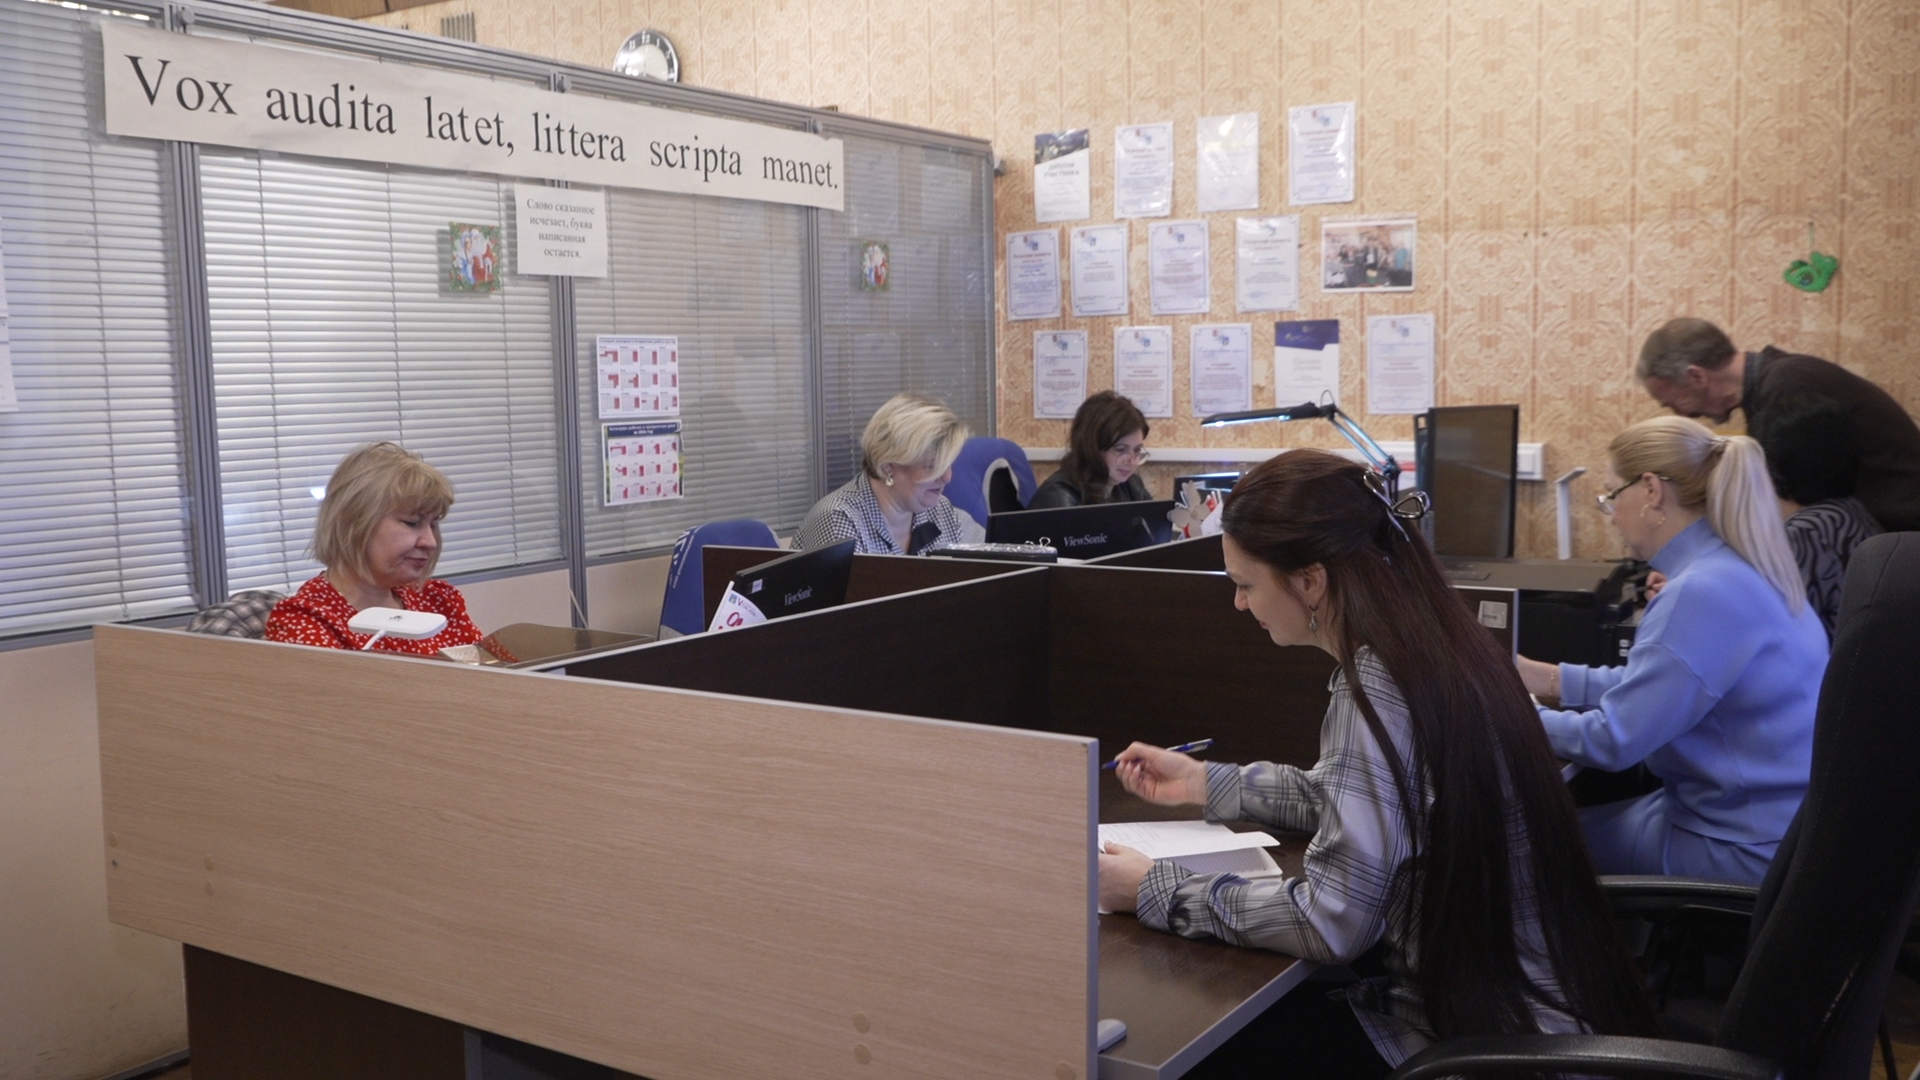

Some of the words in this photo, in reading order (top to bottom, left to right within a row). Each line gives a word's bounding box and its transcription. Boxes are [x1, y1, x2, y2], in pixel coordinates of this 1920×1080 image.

[124, 54, 238, 115] Vox
[265, 83, 397, 134] audita
[424, 96, 515, 156] latet,
[532, 111, 627, 163] littera
[649, 135, 743, 182] scripta
[762, 155, 839, 190] manet.
[526, 198, 553, 211] Слово
[554, 203, 595, 215] сказанное
[529, 216, 569, 229] исчезает,
[570, 217, 593, 231] буква
[538, 232, 586, 244] написанная
[543, 248, 582, 259] остается.
[1063, 532, 1108, 547] ViewSonic
[784, 585, 813, 606] ViewSonic
